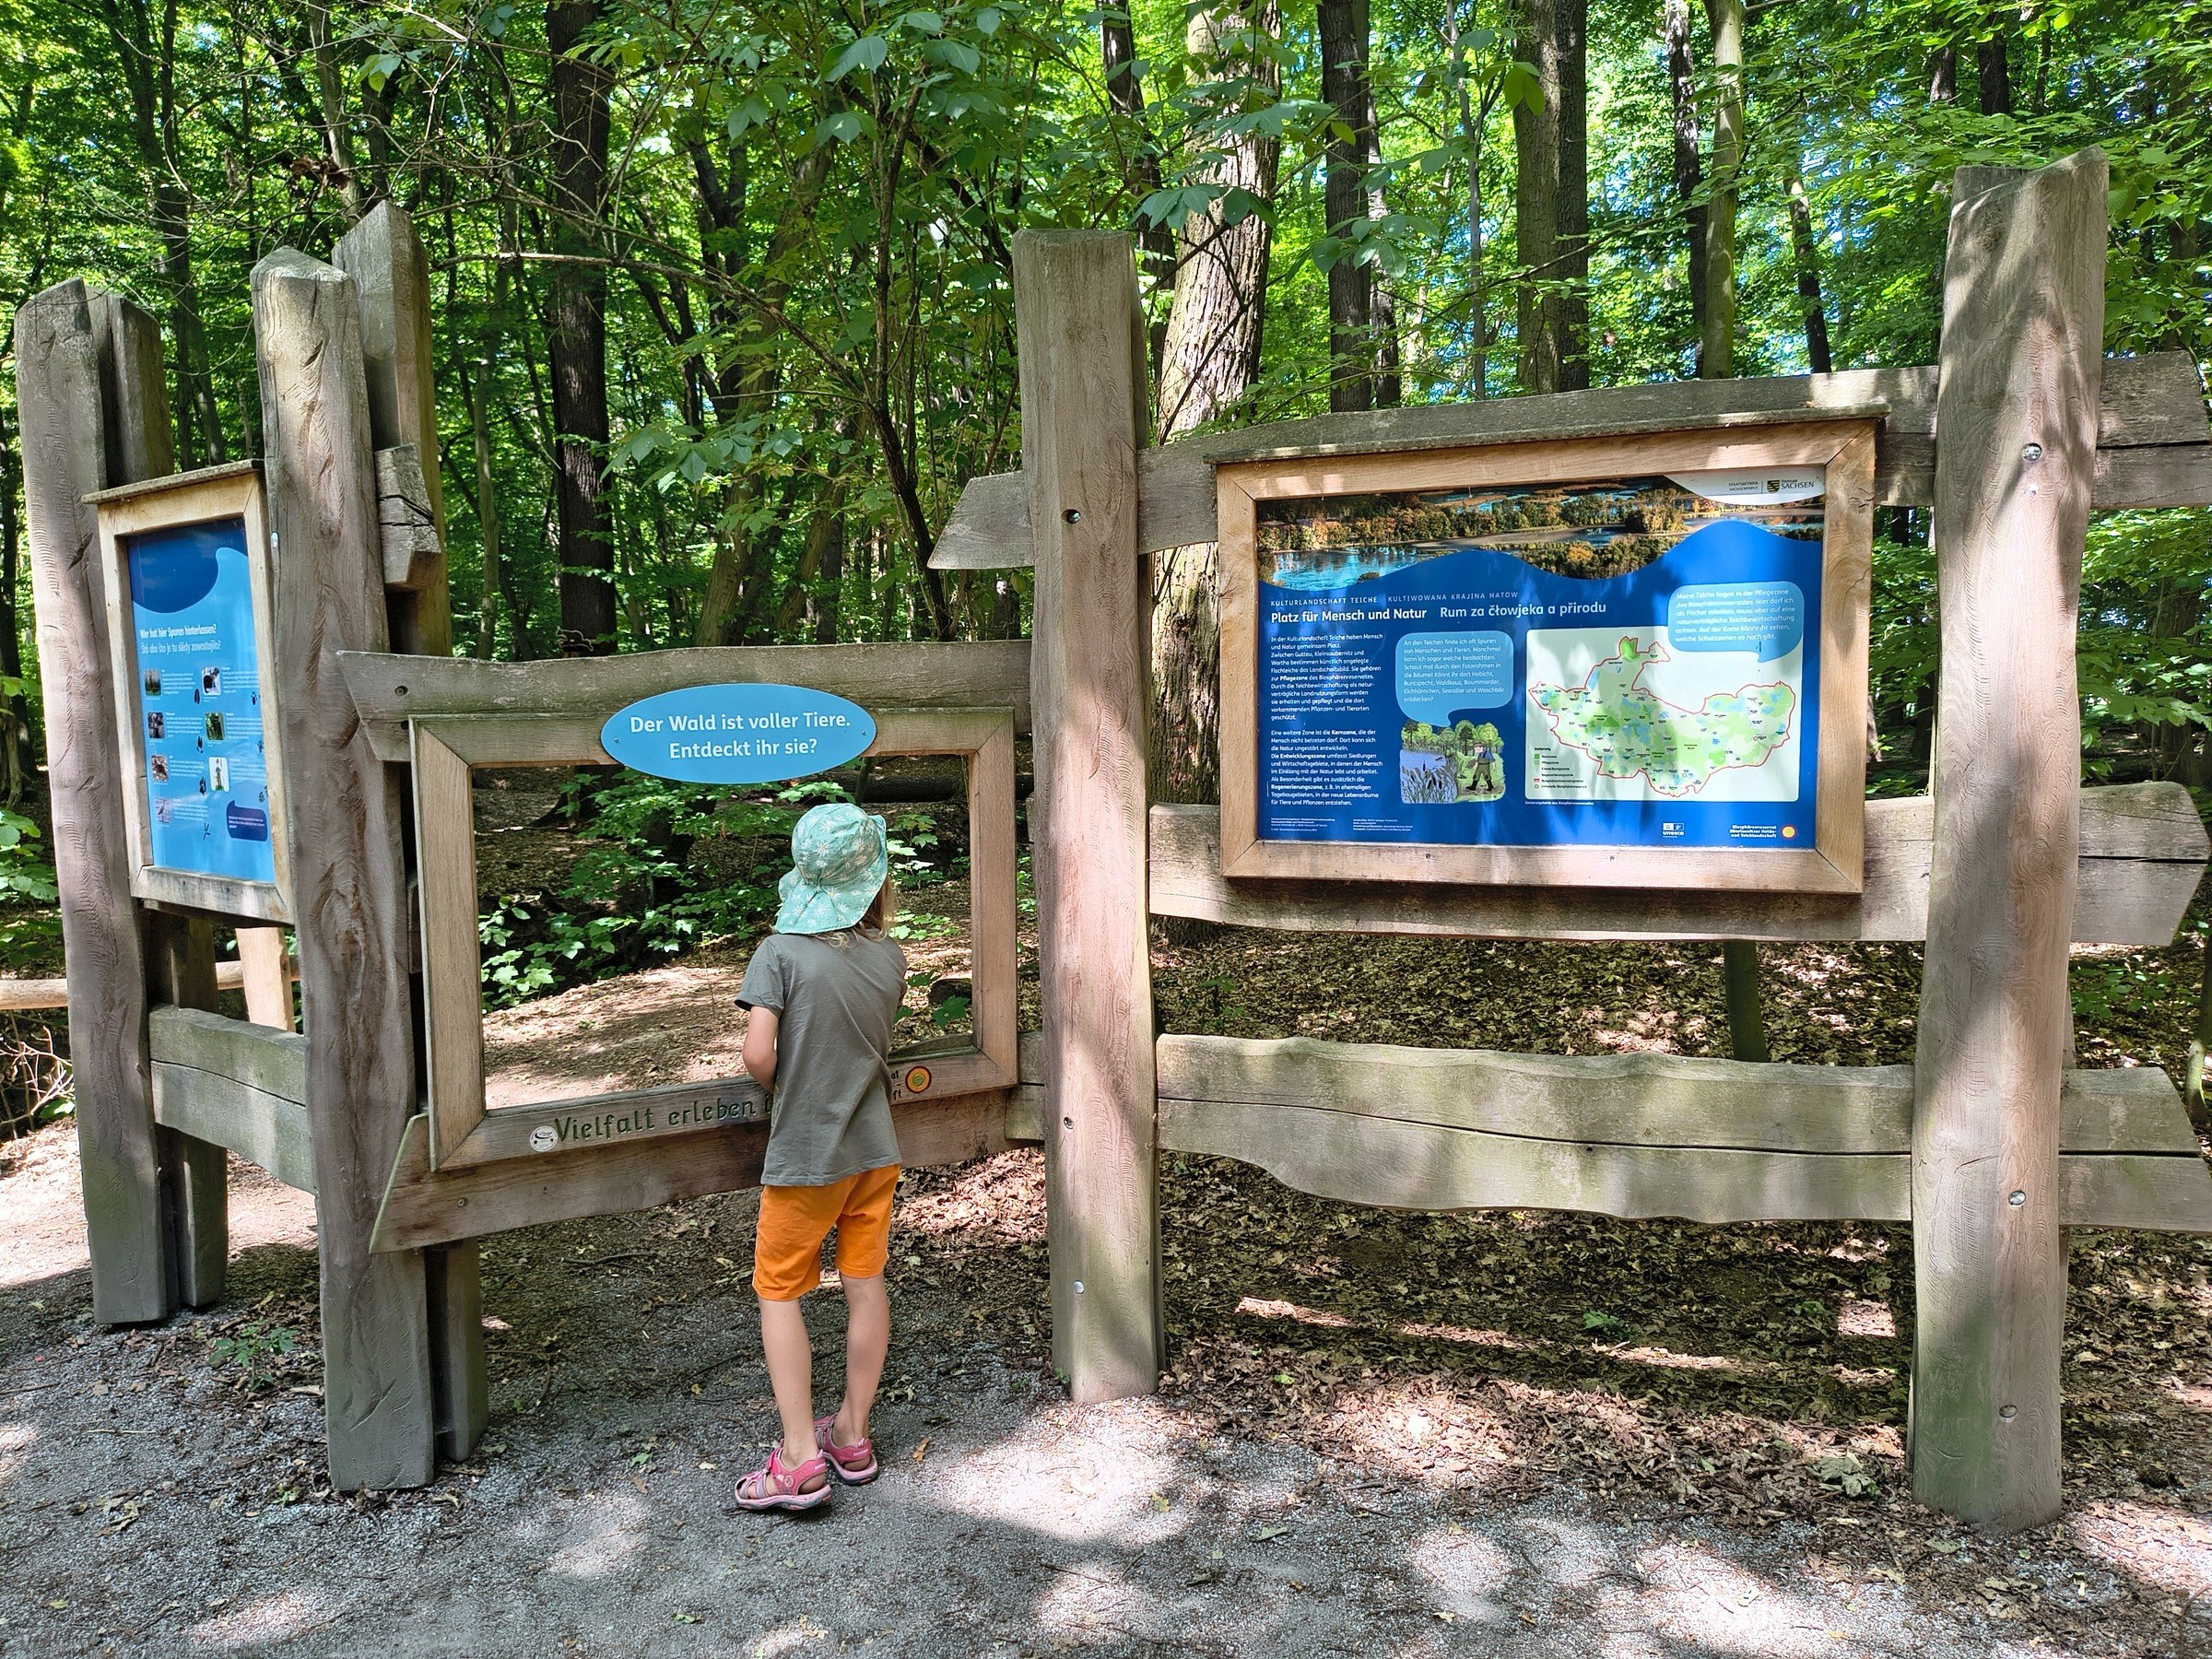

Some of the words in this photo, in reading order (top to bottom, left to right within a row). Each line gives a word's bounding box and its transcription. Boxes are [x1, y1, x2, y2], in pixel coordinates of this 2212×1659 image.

[1781, 481, 1814, 490] SACHSEN
[1271, 597, 1347, 606] KULTURLANDSCHAFT
[1388, 594, 1447, 602] KULTIWOWANA
[1271, 612, 1299, 623] Platz
[1302, 611, 1318, 622] für
[1322, 609, 1364, 621] Mensch
[1368, 608, 1390, 620] und
[1394, 608, 1427, 619] Natur
[1440, 606, 1467, 618] Rum
[1471, 607, 1484, 617] za
[1488, 605, 1544, 618] čłowjeka
[1547, 606, 1556, 614] a
[1559, 602, 1606, 617] přirodu
[630, 715, 664, 733] Der
[668, 714, 716, 732] Wald
[722, 713, 744, 730] ist
[748, 712, 798, 729] voller
[803, 712, 851, 728] Tiere.
[670, 740, 750, 759] Entdeckt
[756, 739, 779, 756] ihr
[785, 738, 818, 755] sie?
[555, 1108, 655, 1143] Vielfalt
[668, 1097, 756, 1126] erleben
